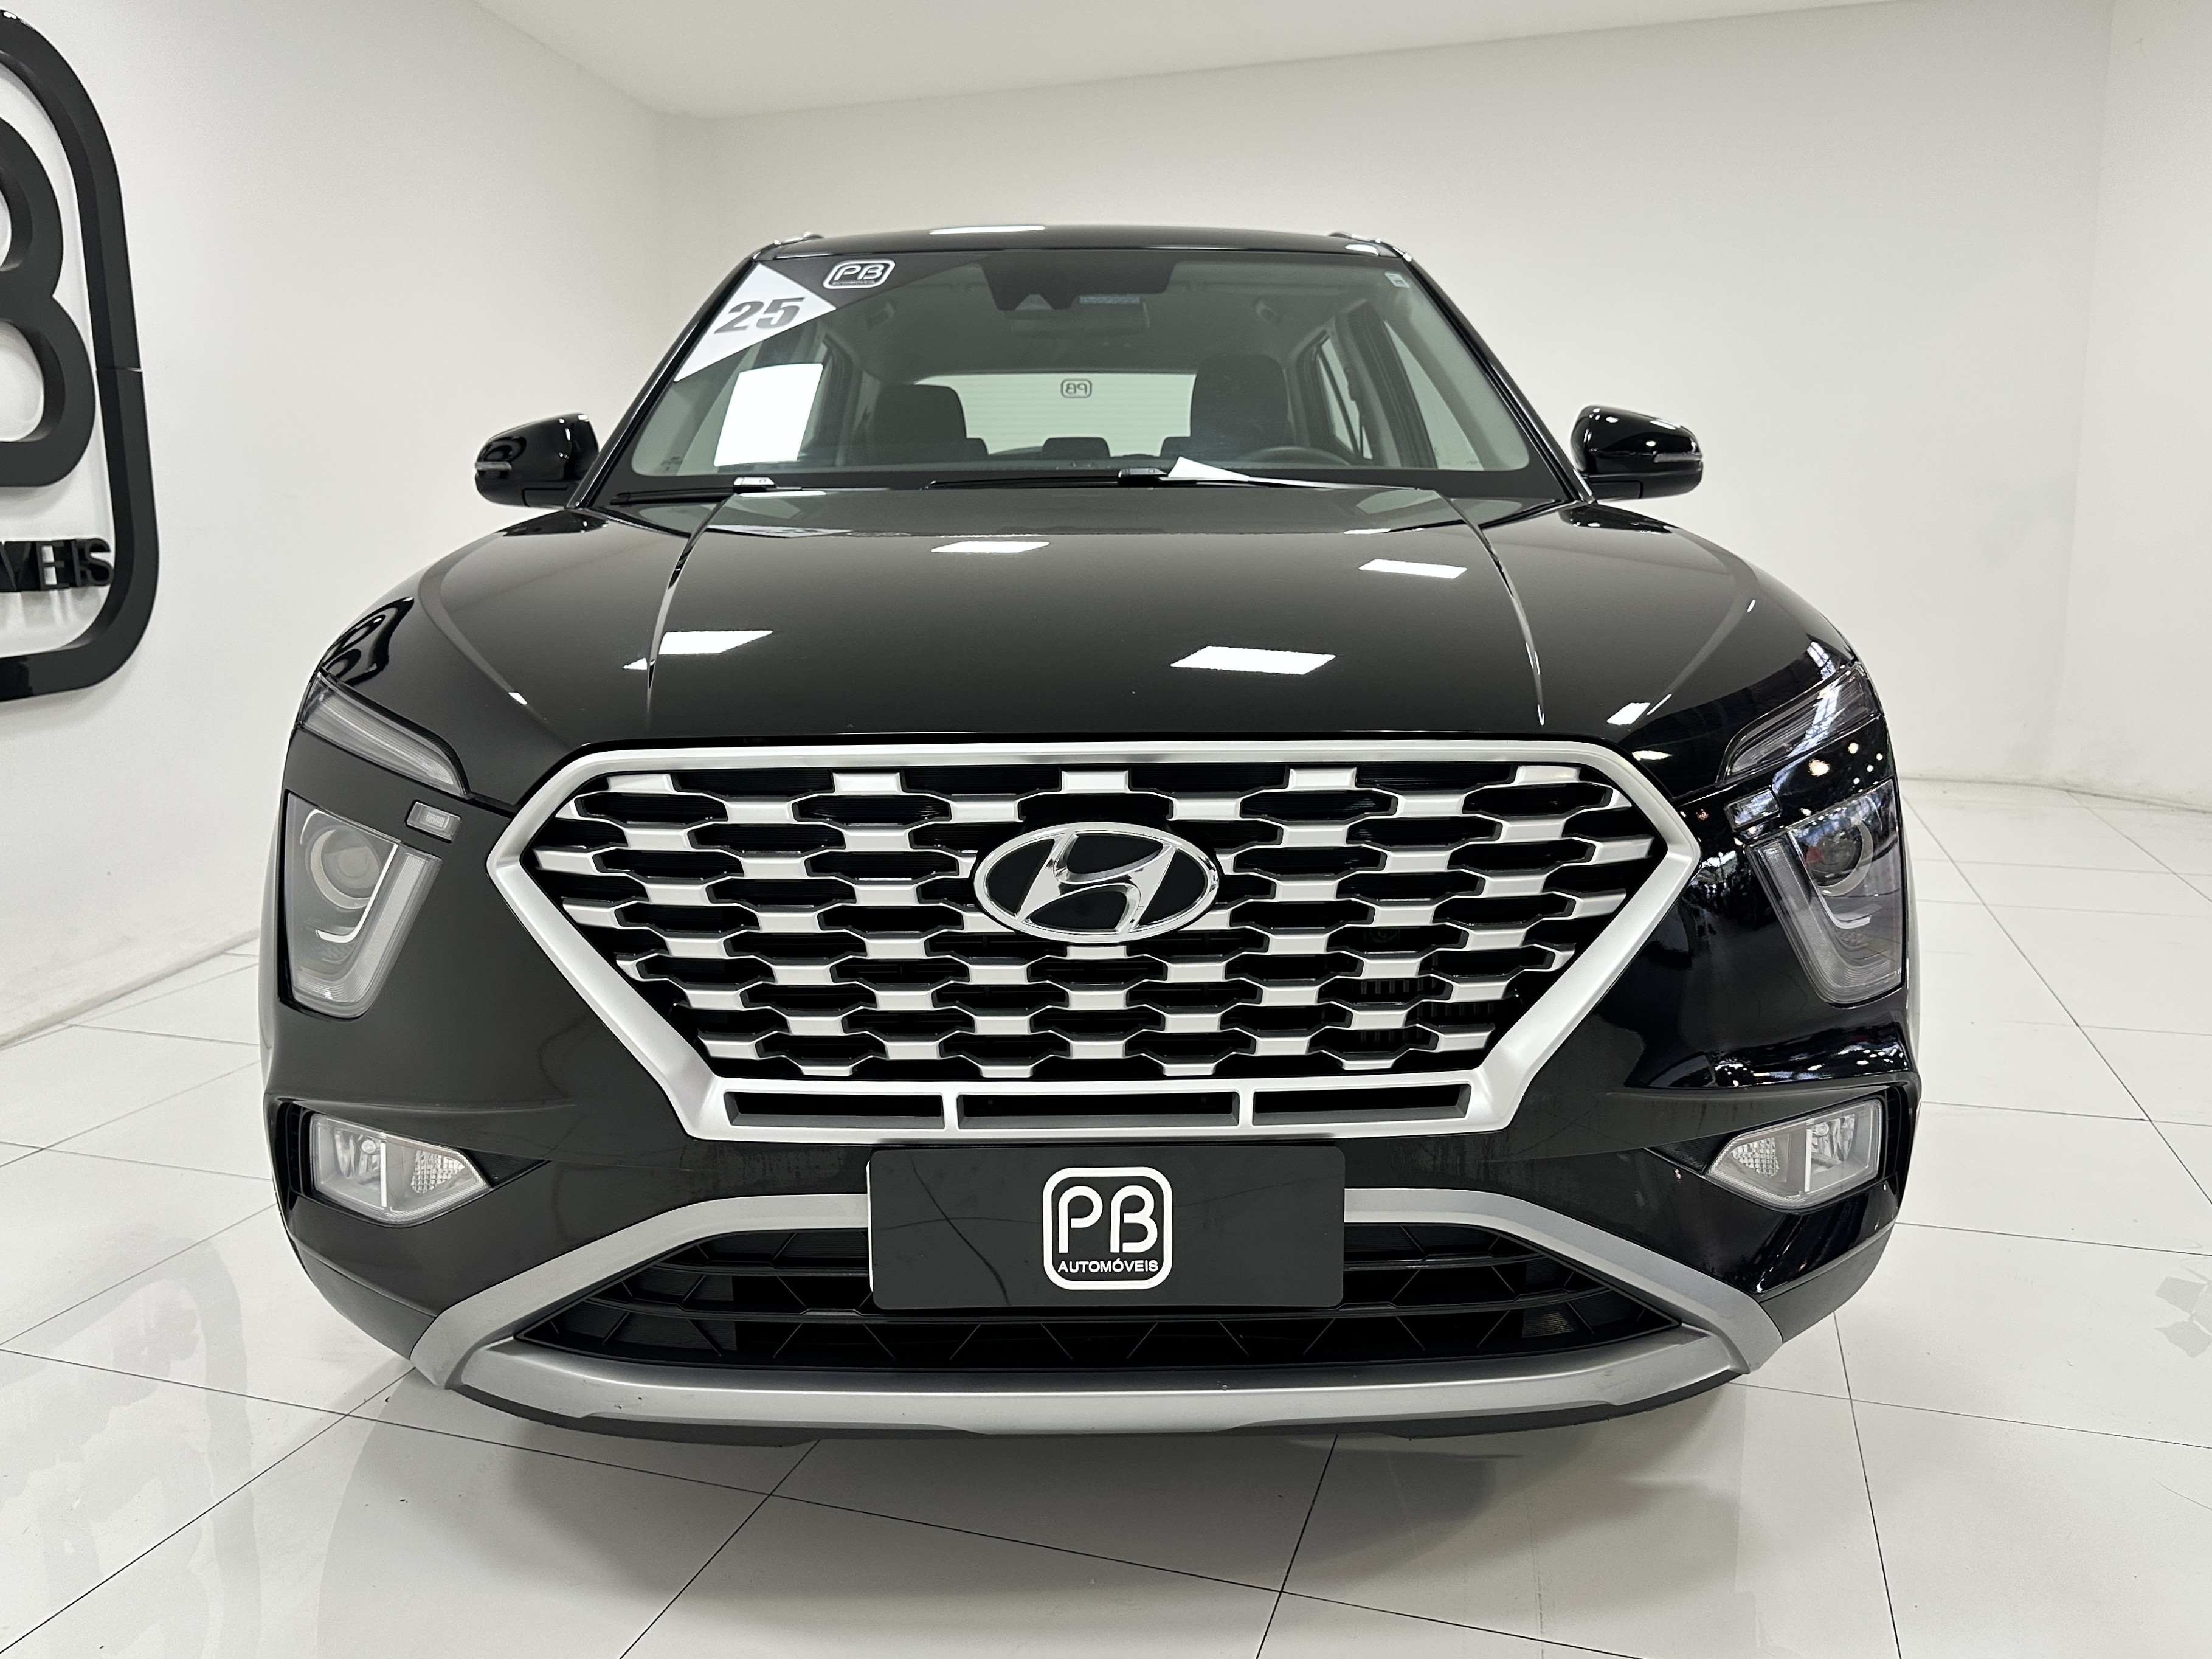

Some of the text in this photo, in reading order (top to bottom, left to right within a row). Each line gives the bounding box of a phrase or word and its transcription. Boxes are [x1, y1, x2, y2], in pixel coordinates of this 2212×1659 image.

[833, 263, 885, 281] PB
[714, 297, 806, 334] 25
[1058, 1185, 1158, 1253] PB
[1057, 1258, 1159, 1273] AUTOMÓVEIS
